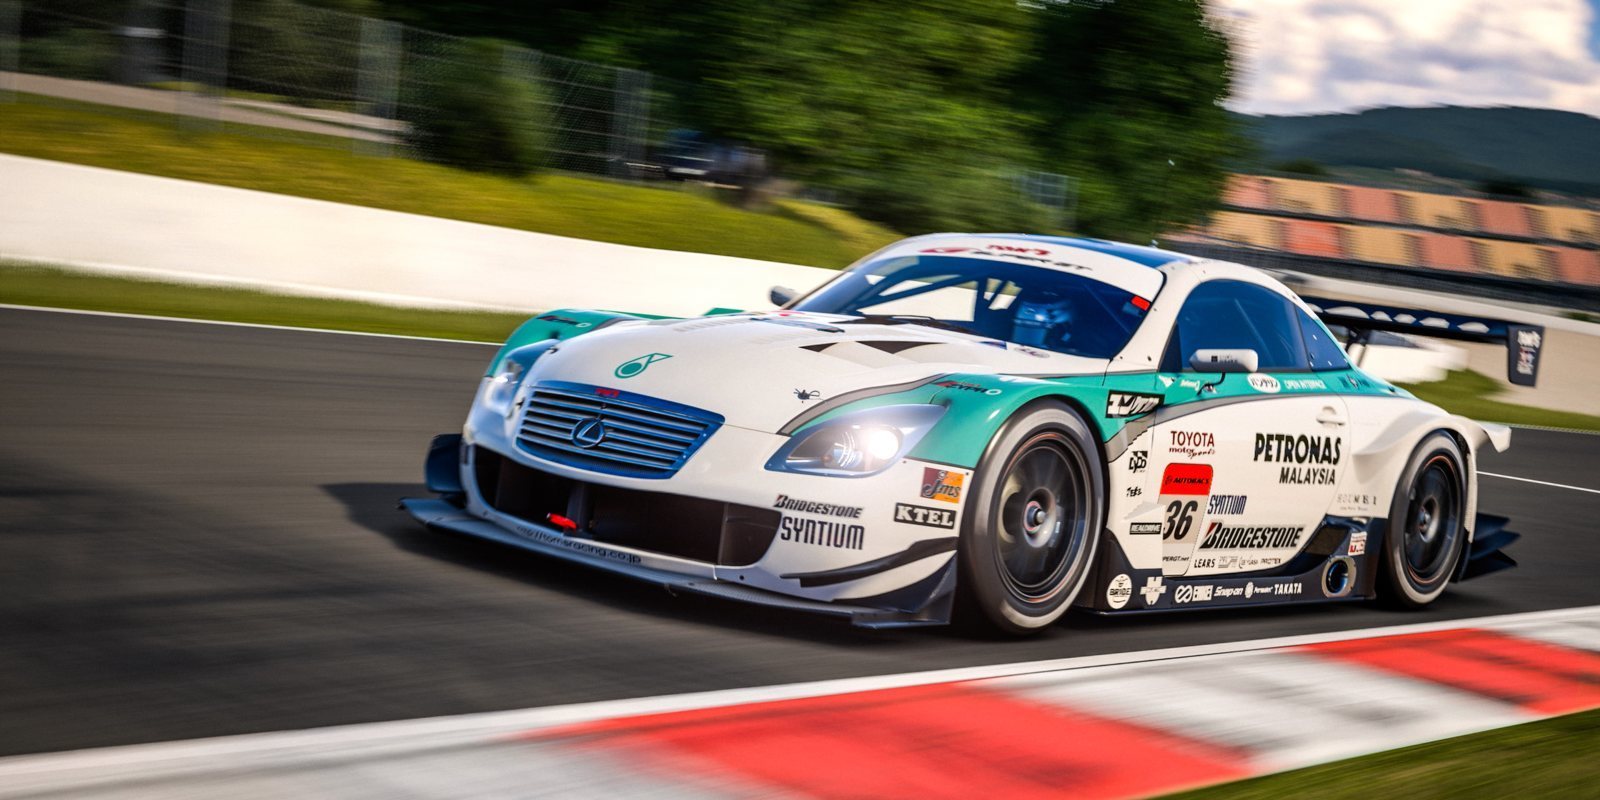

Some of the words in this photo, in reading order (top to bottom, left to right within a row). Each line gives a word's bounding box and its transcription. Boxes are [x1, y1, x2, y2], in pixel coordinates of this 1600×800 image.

[1170, 430, 1215, 447] TOYOTA
[1253, 432, 1342, 466] PETRONAS
[1278, 466, 1336, 486] MALAYSIA
[773, 494, 864, 518] BRIDGESTONE
[1207, 495, 1247, 515] SYNTIUM
[896, 506, 953, 527] KTEL
[1162, 500, 1198, 540] 36
[781, 516, 865, 550] SYNTIUM
[1199, 522, 1304, 549] BRIDGESTONE
[1194, 559, 1216, 568] LEARS
[1109, 588, 1131, 596] BRIDE
[1214, 586, 1243, 597] Snap-on
[1274, 583, 1302, 595] TAKATA
